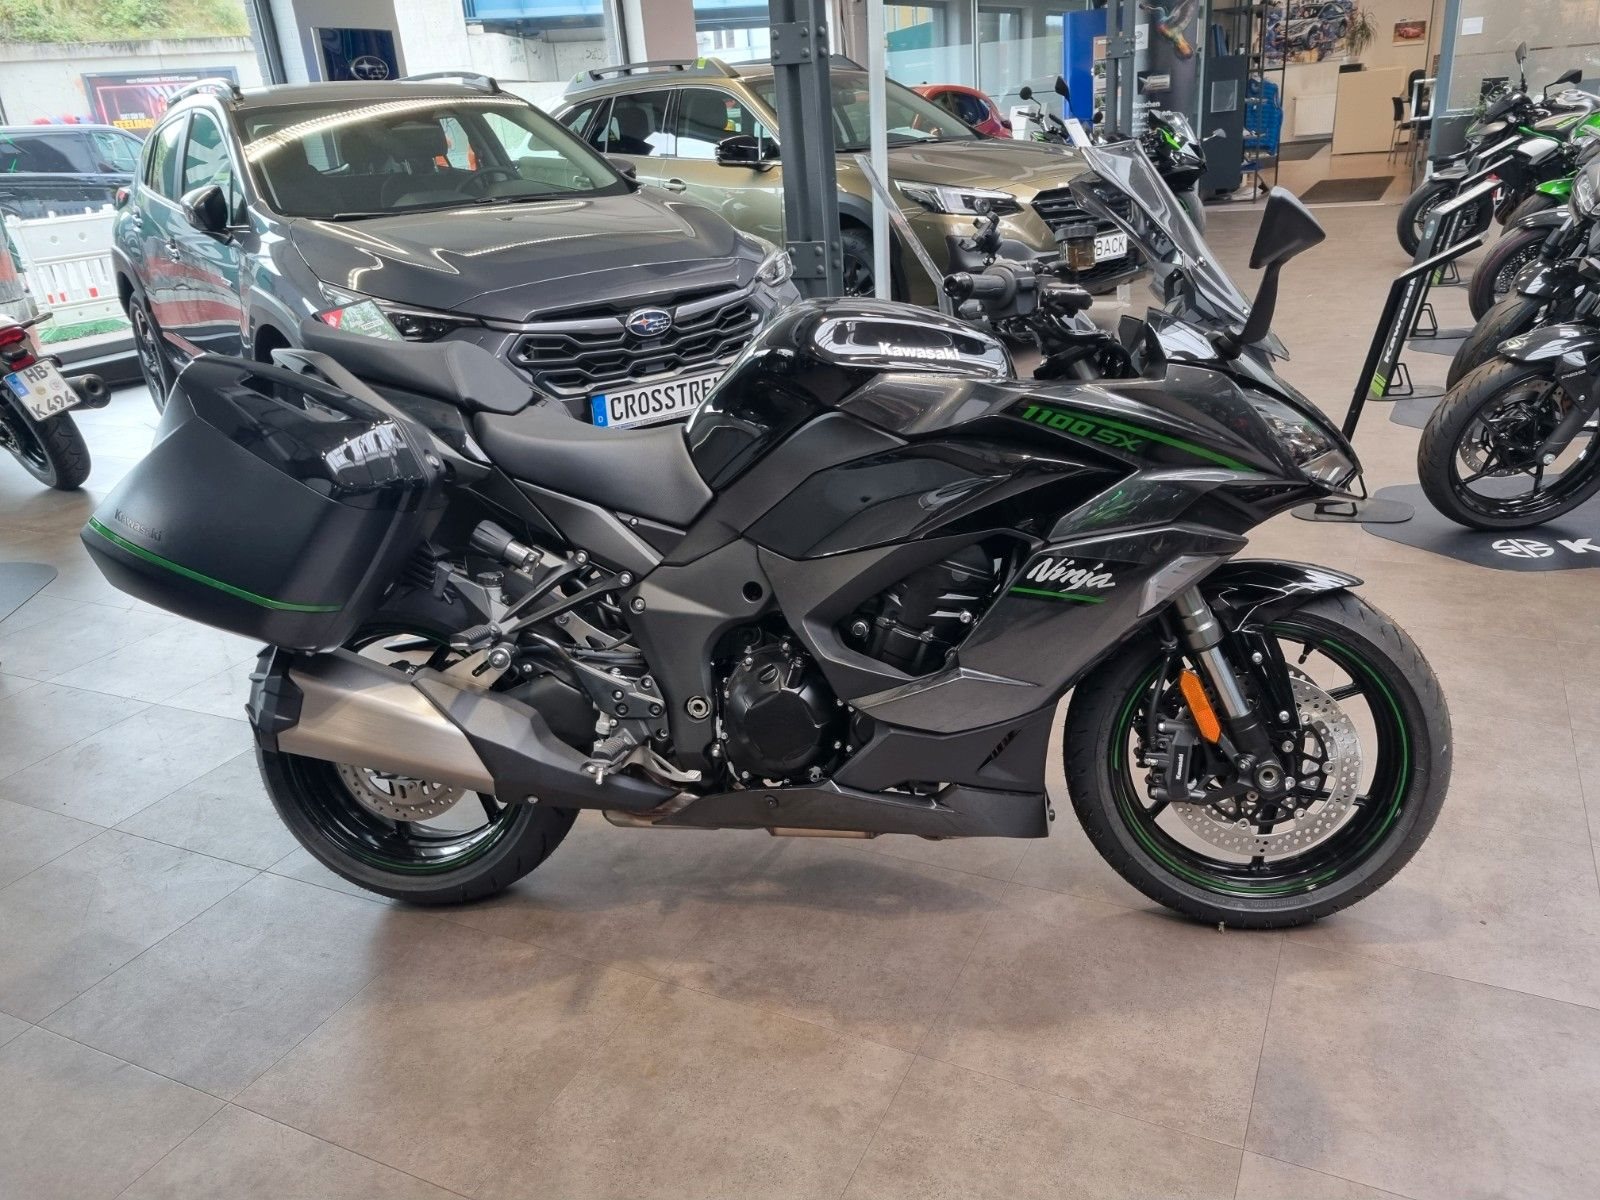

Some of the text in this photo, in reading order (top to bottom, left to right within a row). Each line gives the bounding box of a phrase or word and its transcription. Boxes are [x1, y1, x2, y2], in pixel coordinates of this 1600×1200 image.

[878, 341, 961, 360] Kawasaki
[23, 365, 49, 383] HB
[31, 390, 76, 419] K 494
[610, 377, 719, 421] CROSSTRE
[1022, 405, 1143, 453] 1100 SX
[114, 509, 162, 541] Kawasaki
[1026, 557, 1116, 592] Ninja
[1175, 753, 1184, 780] Kawasaki
